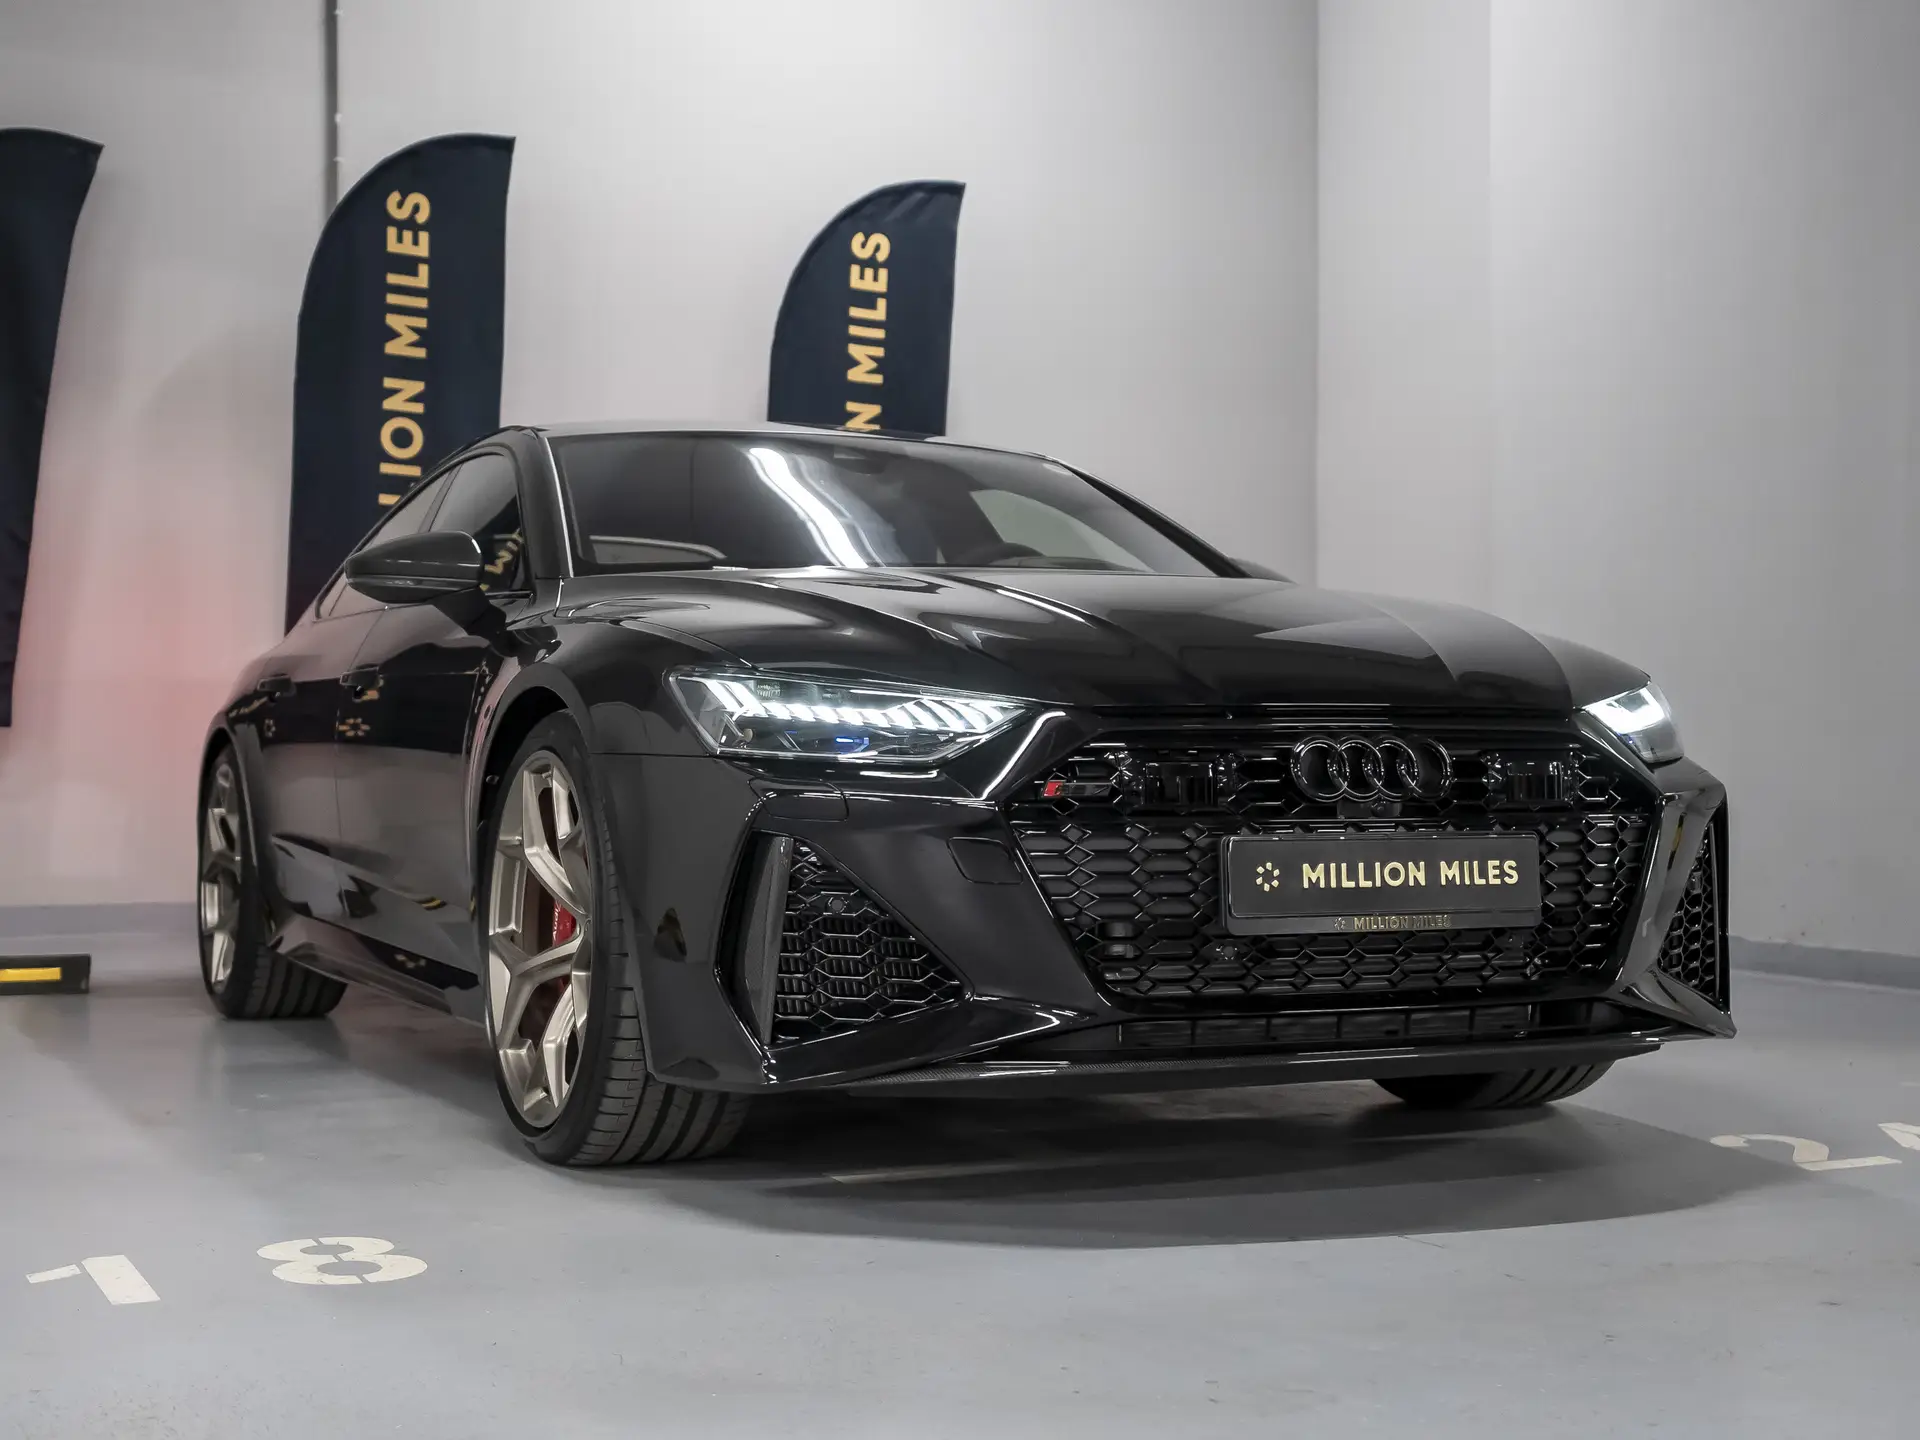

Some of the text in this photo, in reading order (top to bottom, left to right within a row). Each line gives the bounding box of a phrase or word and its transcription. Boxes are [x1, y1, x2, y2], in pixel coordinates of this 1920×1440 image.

[384, 190, 431, 359] MILES
[847, 231, 891, 385] MILES
[1302, 859, 1519, 889] MILLION MILES
[1354, 914, 1451, 930] MILLION MILES
